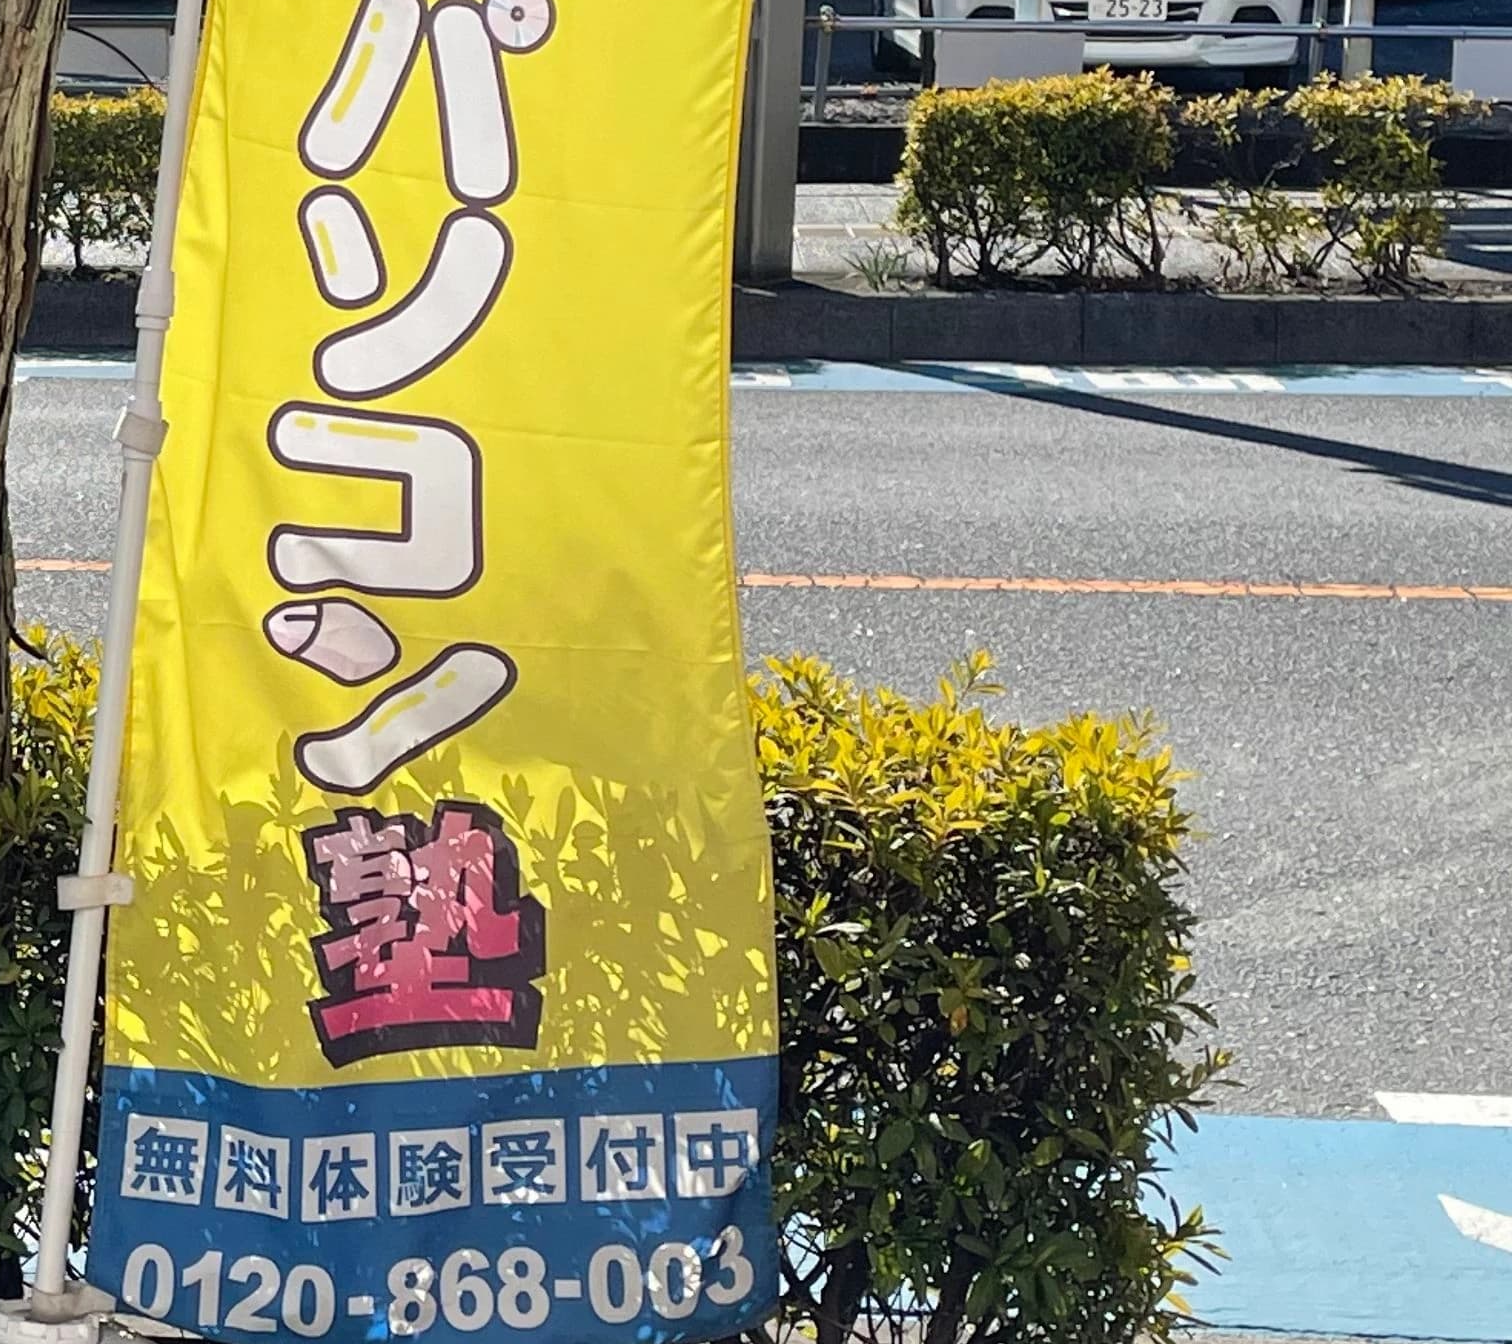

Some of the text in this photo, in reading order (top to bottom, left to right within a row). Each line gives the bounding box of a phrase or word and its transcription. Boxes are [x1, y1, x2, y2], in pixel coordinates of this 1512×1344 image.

[126, 1118, 756, 1219] 無料体験受付中
[121, 1225, 755, 1337] 0120-868-003
